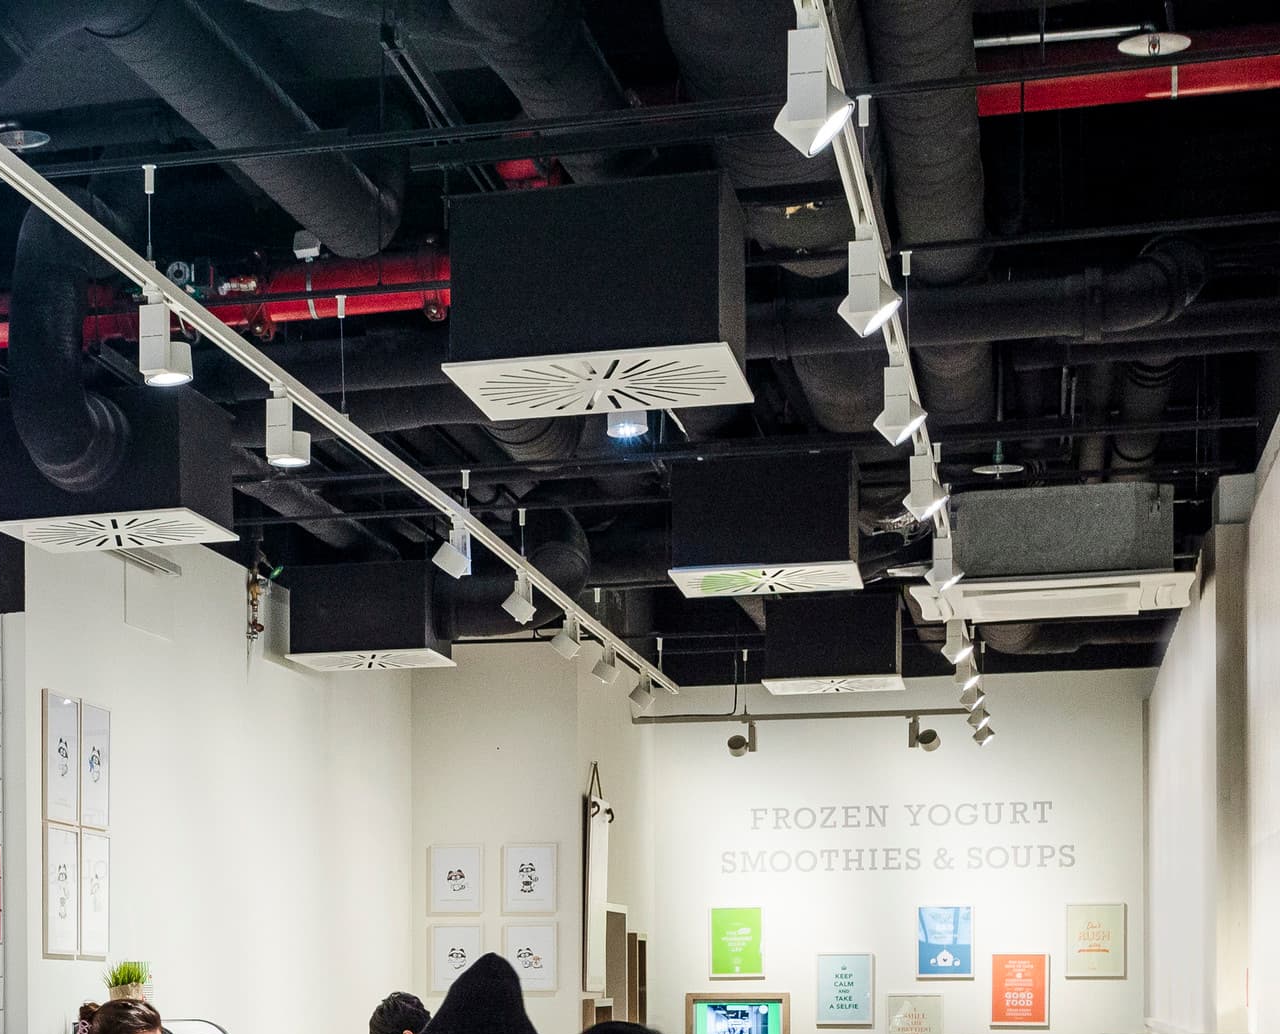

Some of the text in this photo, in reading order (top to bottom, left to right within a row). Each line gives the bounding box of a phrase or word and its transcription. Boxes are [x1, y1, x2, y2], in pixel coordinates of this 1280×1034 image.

[750, 801, 1053, 831] FROZEN YOGURT
[720, 844, 1076, 875] SMOOTHIES & SOUPS
[1005, 991, 1033, 1000] GOOD
